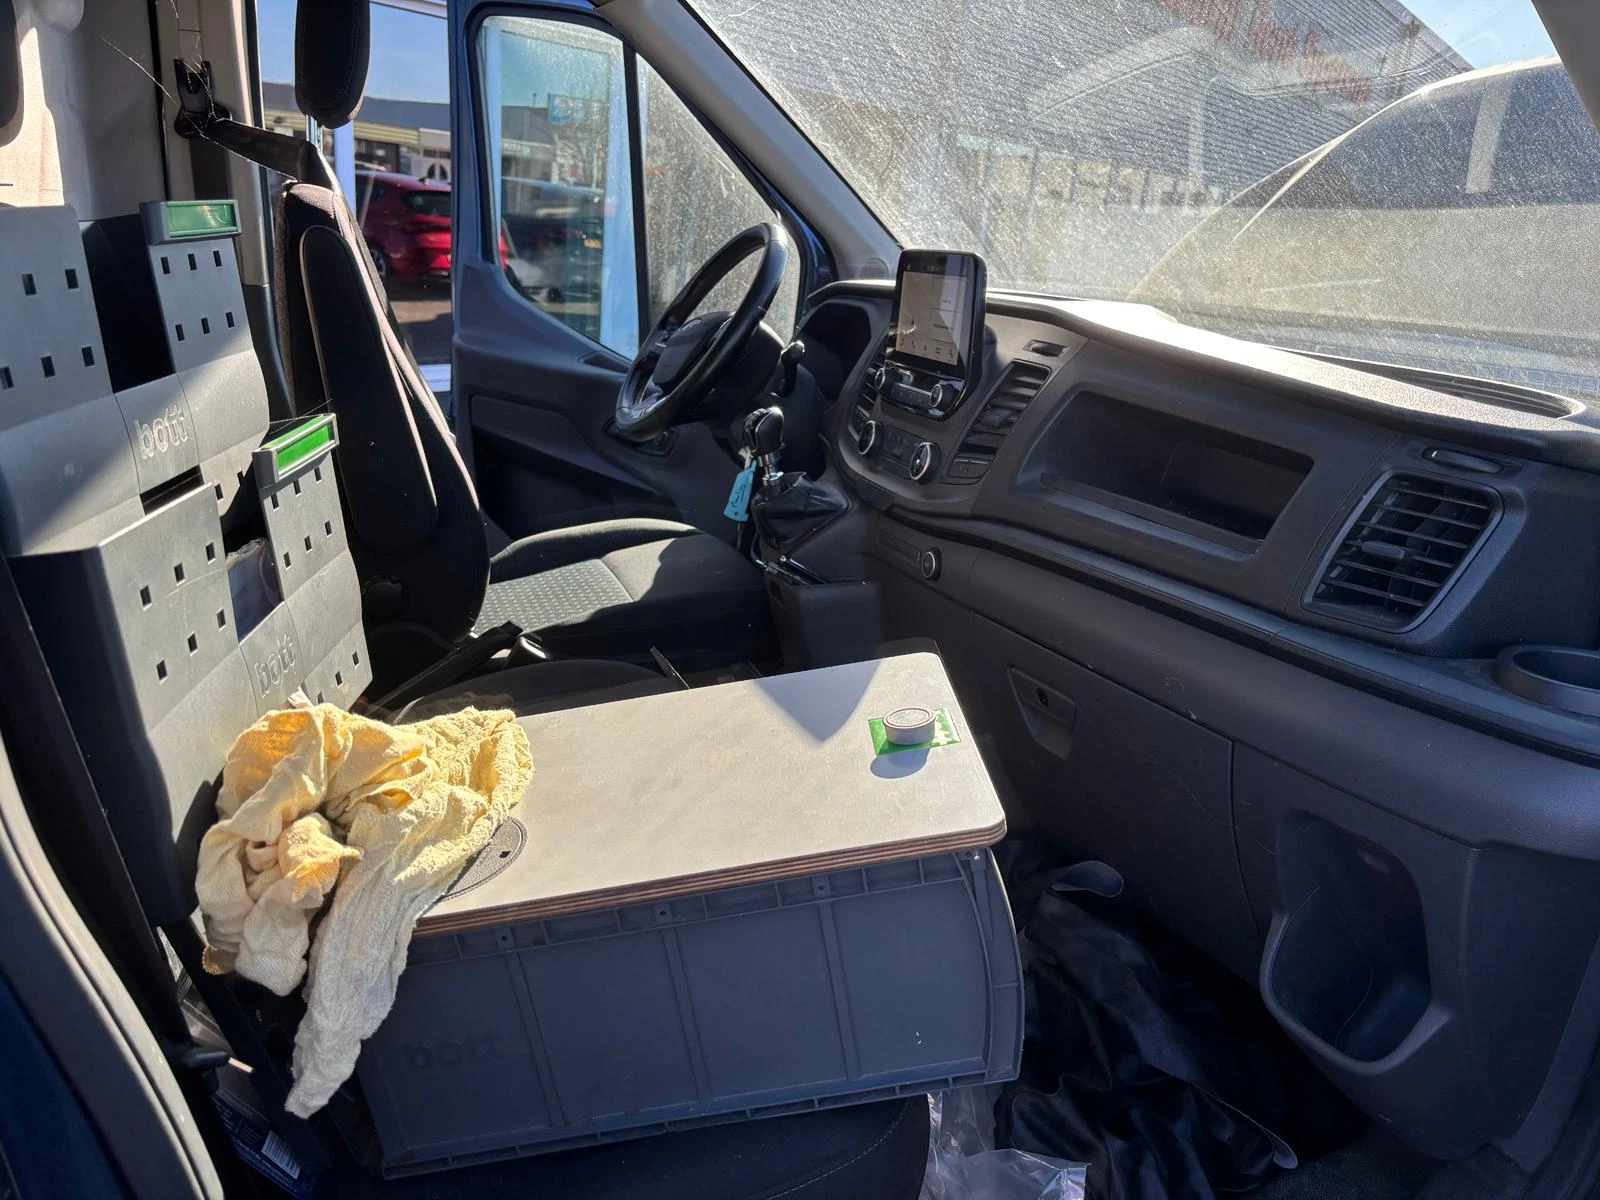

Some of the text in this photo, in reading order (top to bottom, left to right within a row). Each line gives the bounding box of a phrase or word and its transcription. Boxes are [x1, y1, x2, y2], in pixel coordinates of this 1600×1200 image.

[134, 404, 189, 460] bott
[254, 633, 297, 699] bott
[402, 1029, 501, 1072] bott
